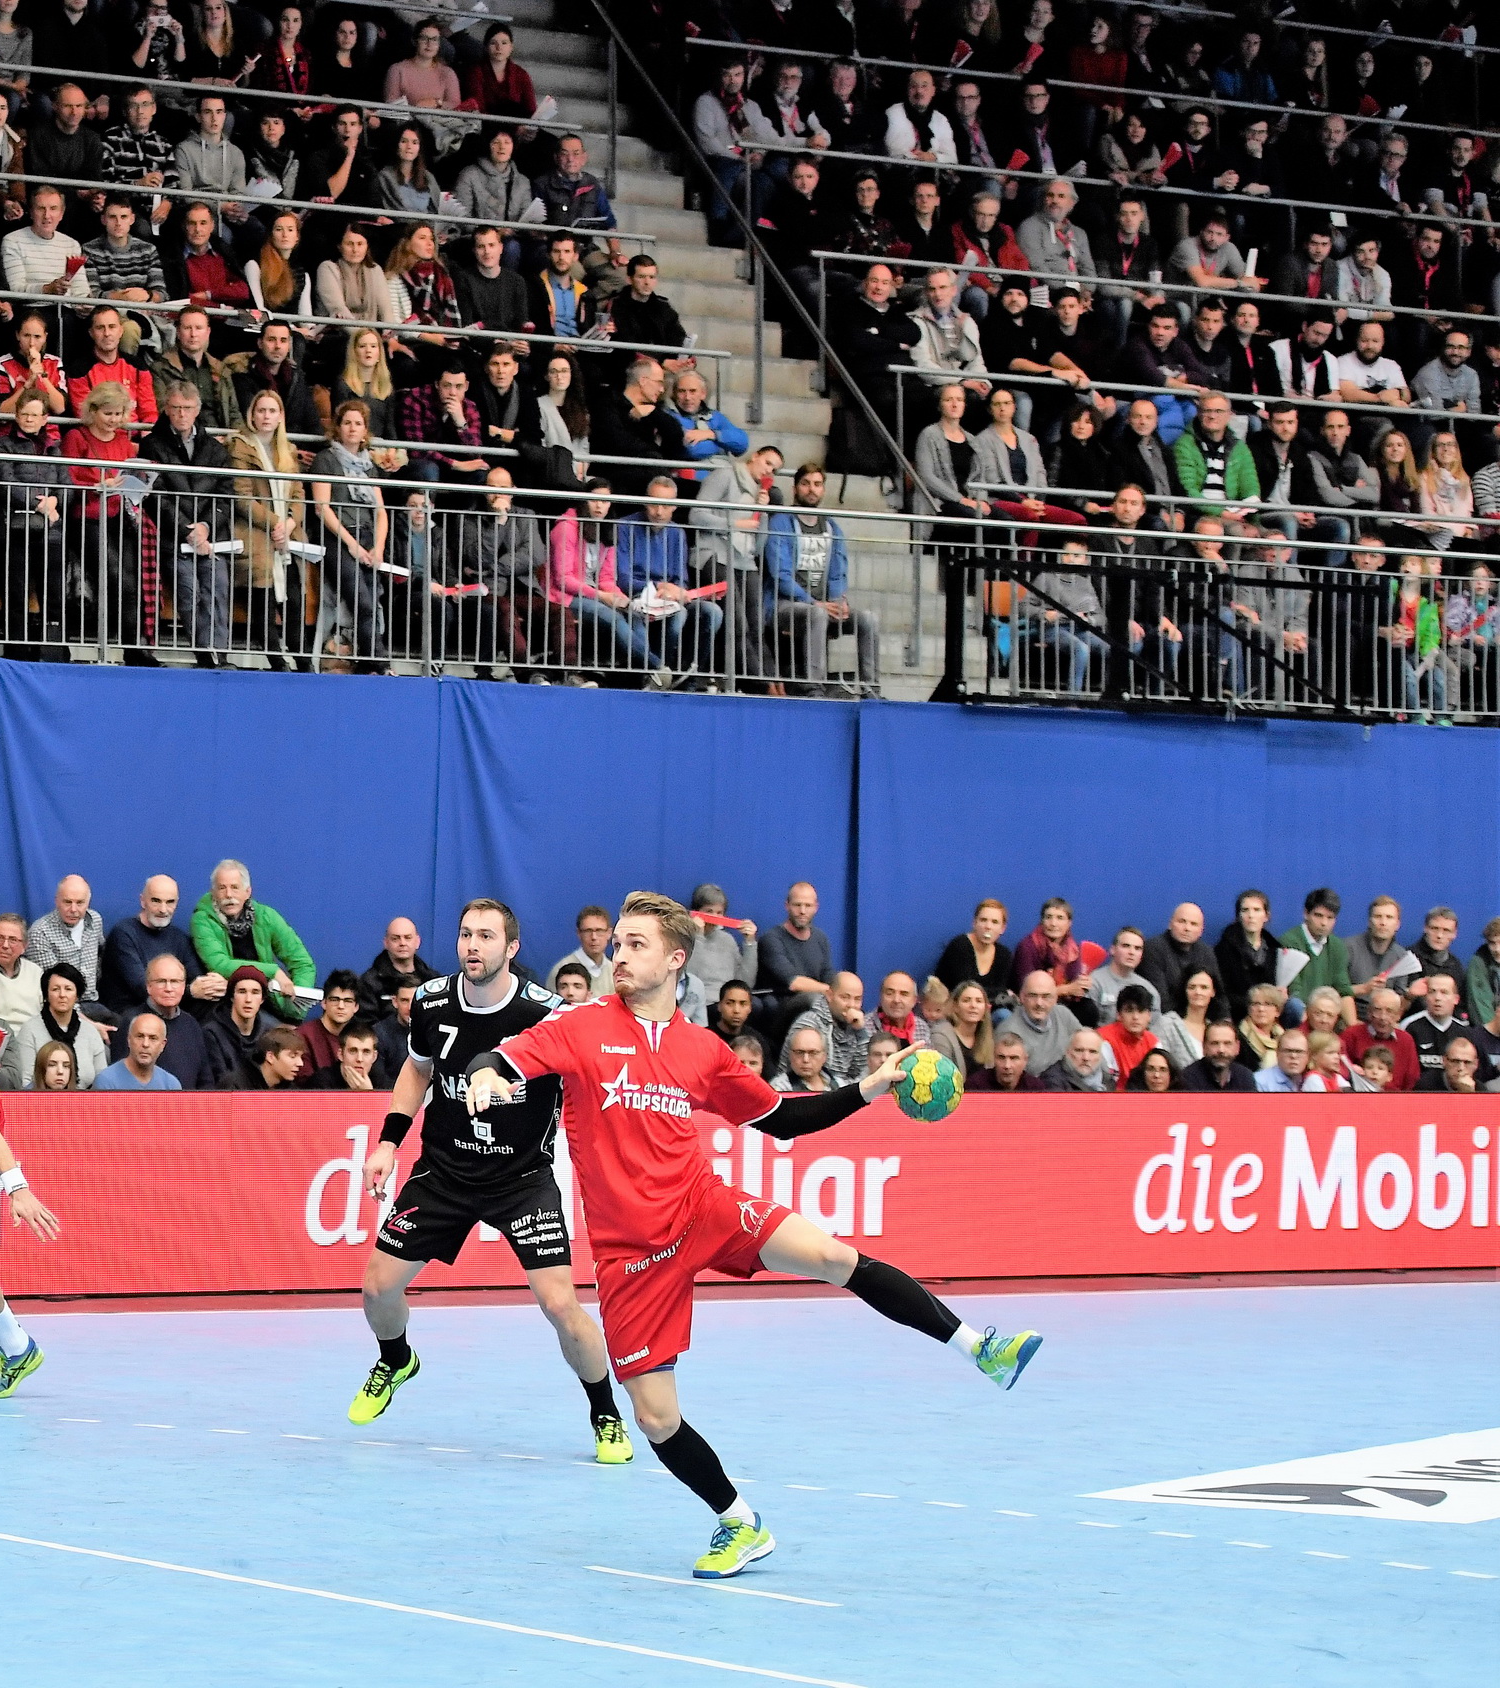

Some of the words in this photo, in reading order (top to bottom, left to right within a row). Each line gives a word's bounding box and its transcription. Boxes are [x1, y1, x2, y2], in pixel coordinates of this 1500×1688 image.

[422, 997, 450, 1011] Kempa
[438, 1023, 459, 1060] 7
[601, 1043, 637, 1056] hummel
[643, 1081, 658, 1093] die
[454, 1138, 482, 1154] Bank
[482, 1143, 514, 1155] Linth
[1134, 1122, 1264, 1235] die
[1277, 1123, 1500, 1232] Mobi
[536, 1246, 565, 1257] Kempa
[624, 1256, 651, 1275] Peter
[615, 1345, 651, 1368] hummel
